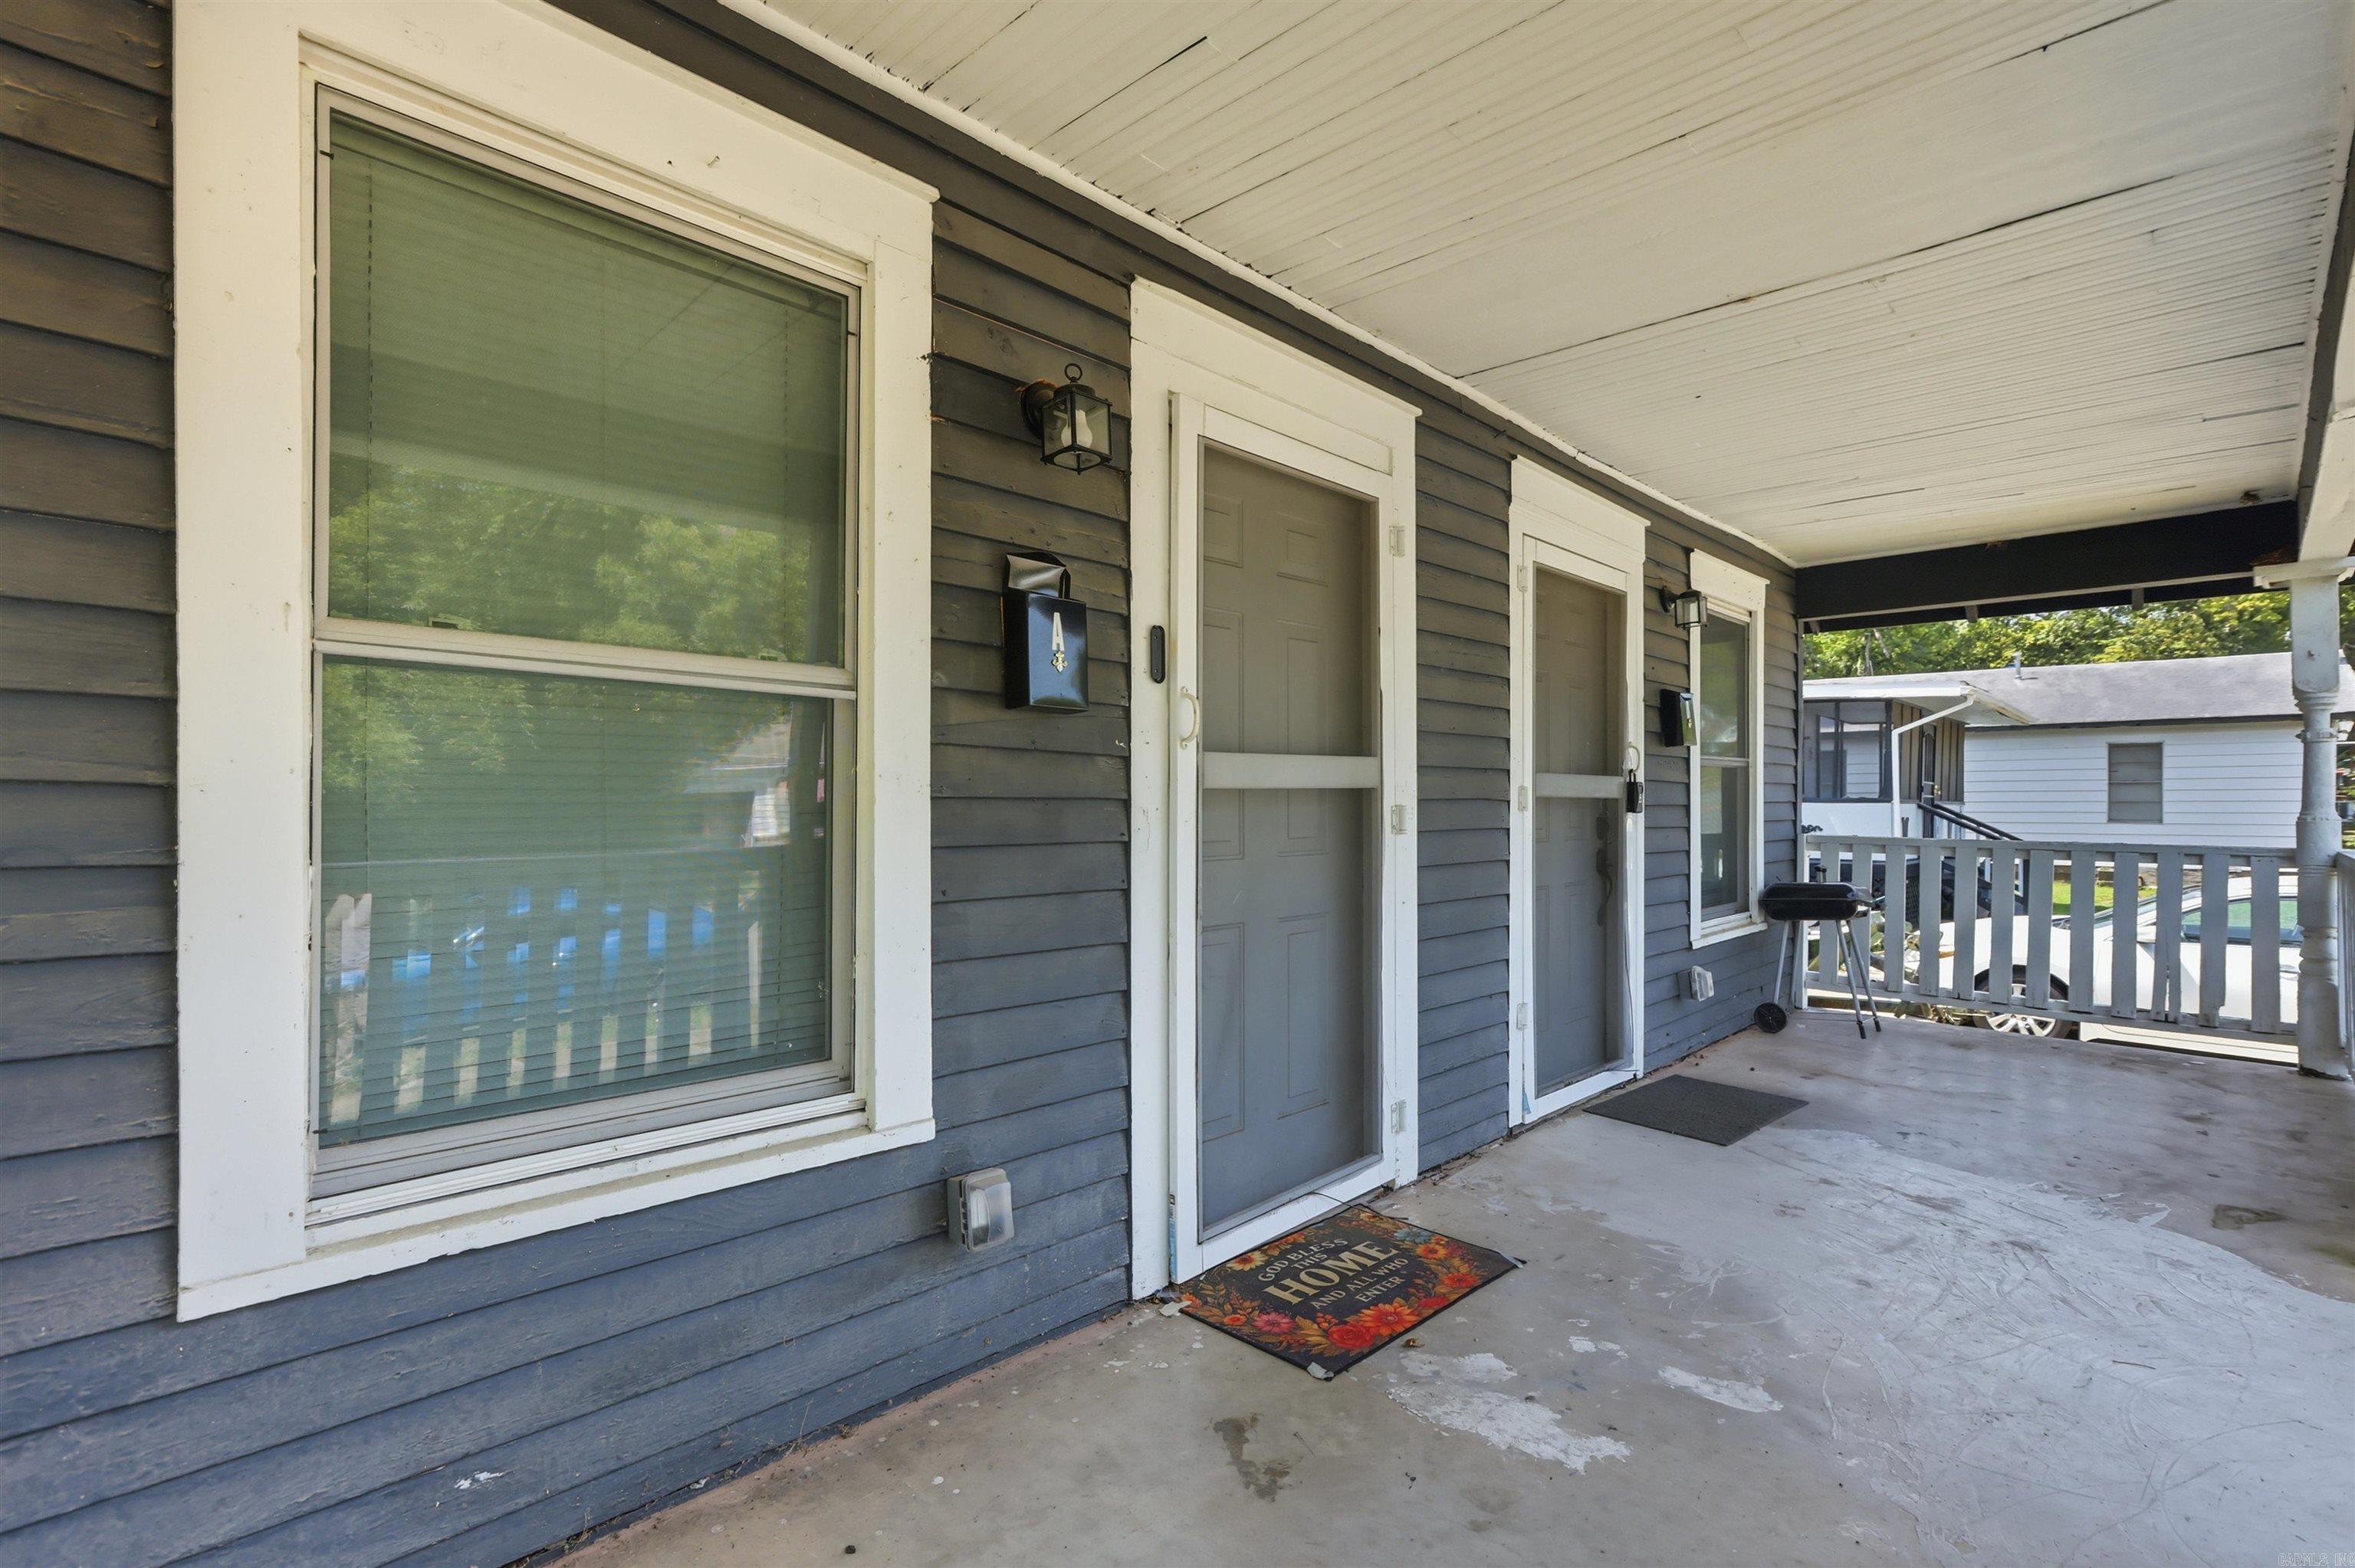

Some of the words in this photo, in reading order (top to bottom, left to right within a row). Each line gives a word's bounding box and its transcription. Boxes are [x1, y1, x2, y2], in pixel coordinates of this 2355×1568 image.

[1052, 612, 1065, 651] A
[1258, 1260, 1289, 1281] GOD
[1288, 1238, 1348, 1261] BLESS
[1263, 1241, 1400, 1305] HOME
[1292, 1252, 1328, 1270] THIS
[1311, 1290, 1346, 1309] AND
[1347, 1276, 1378, 1291] ALL
[1371, 1258, 1408, 1276] WHO
[1355, 1276, 1406, 1302] ENTER
